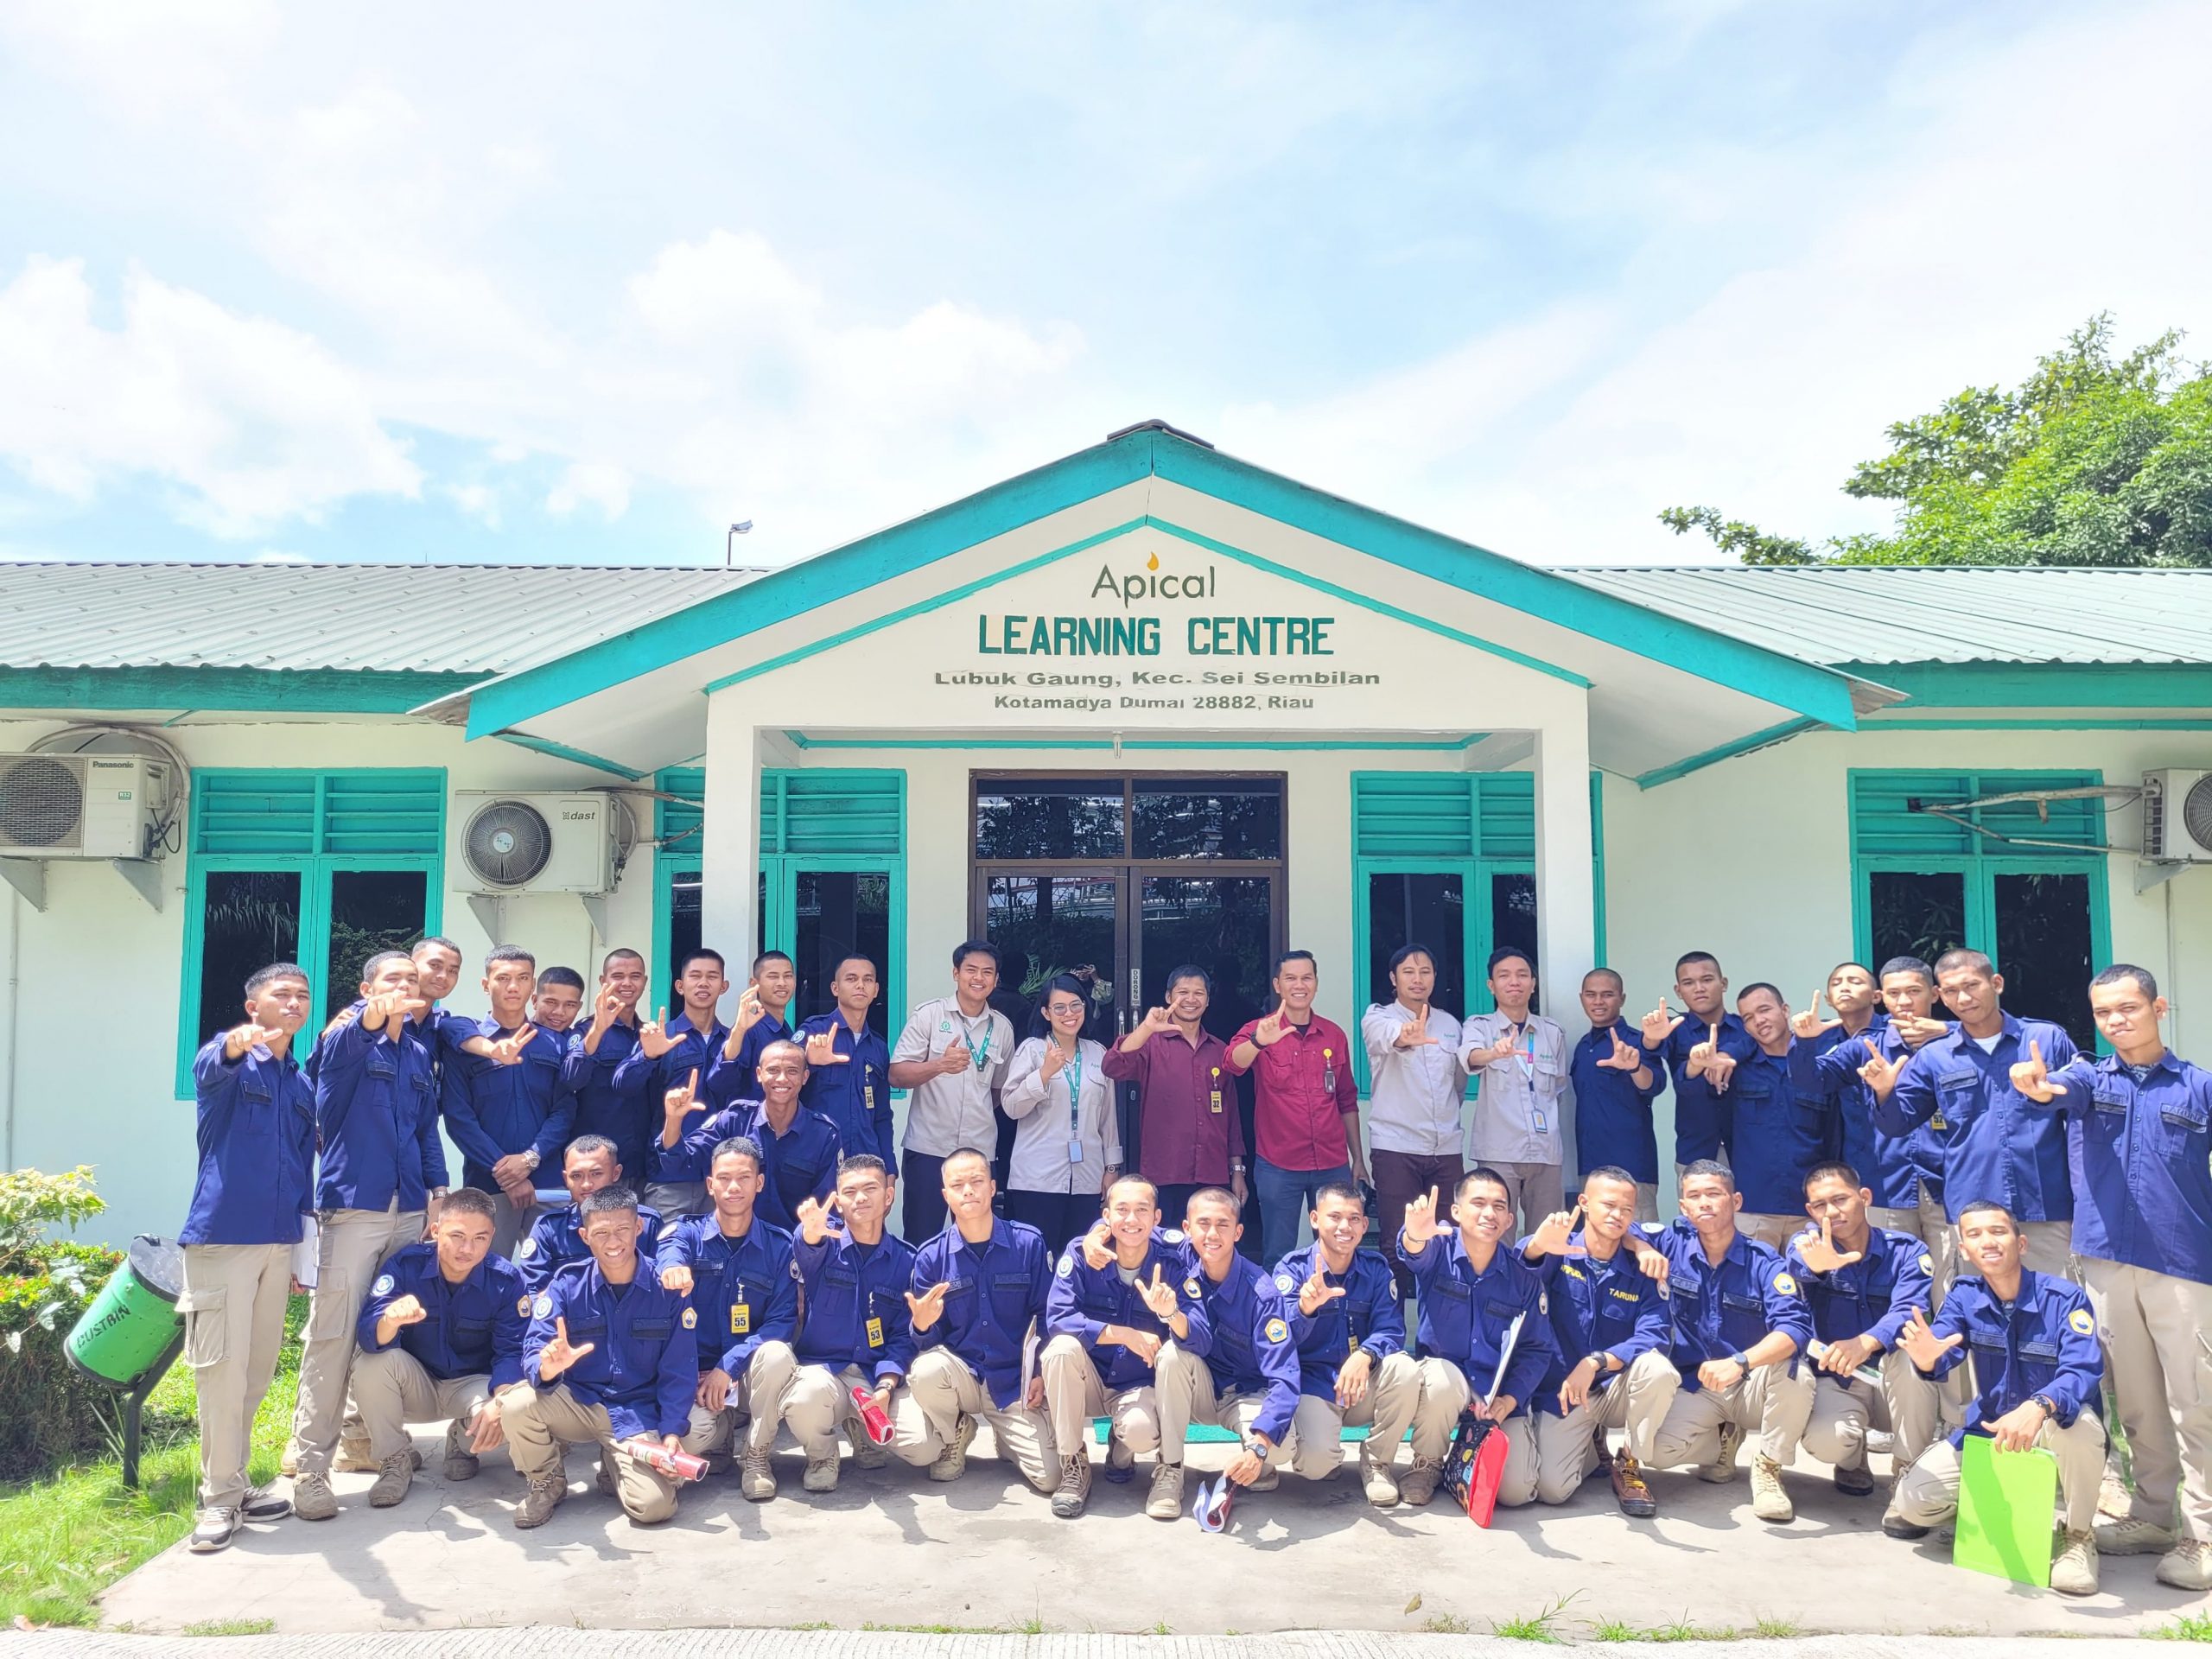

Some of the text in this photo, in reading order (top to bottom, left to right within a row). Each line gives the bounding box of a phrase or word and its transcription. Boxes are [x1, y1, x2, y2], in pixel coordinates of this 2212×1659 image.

[1091, 563, 1216, 608] Apical
[979, 614, 1335, 655] LEARNING CENTRE
[935, 671, 1380, 688] Lubuk Gaung, Kec. Sei Sembilan
[1120, 696, 1185, 709] Dumai
[1192, 696, 1262, 710] 28882,
[1268, 696, 1313, 709] Riau
[1609, 1287, 1639, 1302] TARUNA
[76, 1304, 131, 1349] DUSTBIN
[734, 1317, 746, 1326] 55
